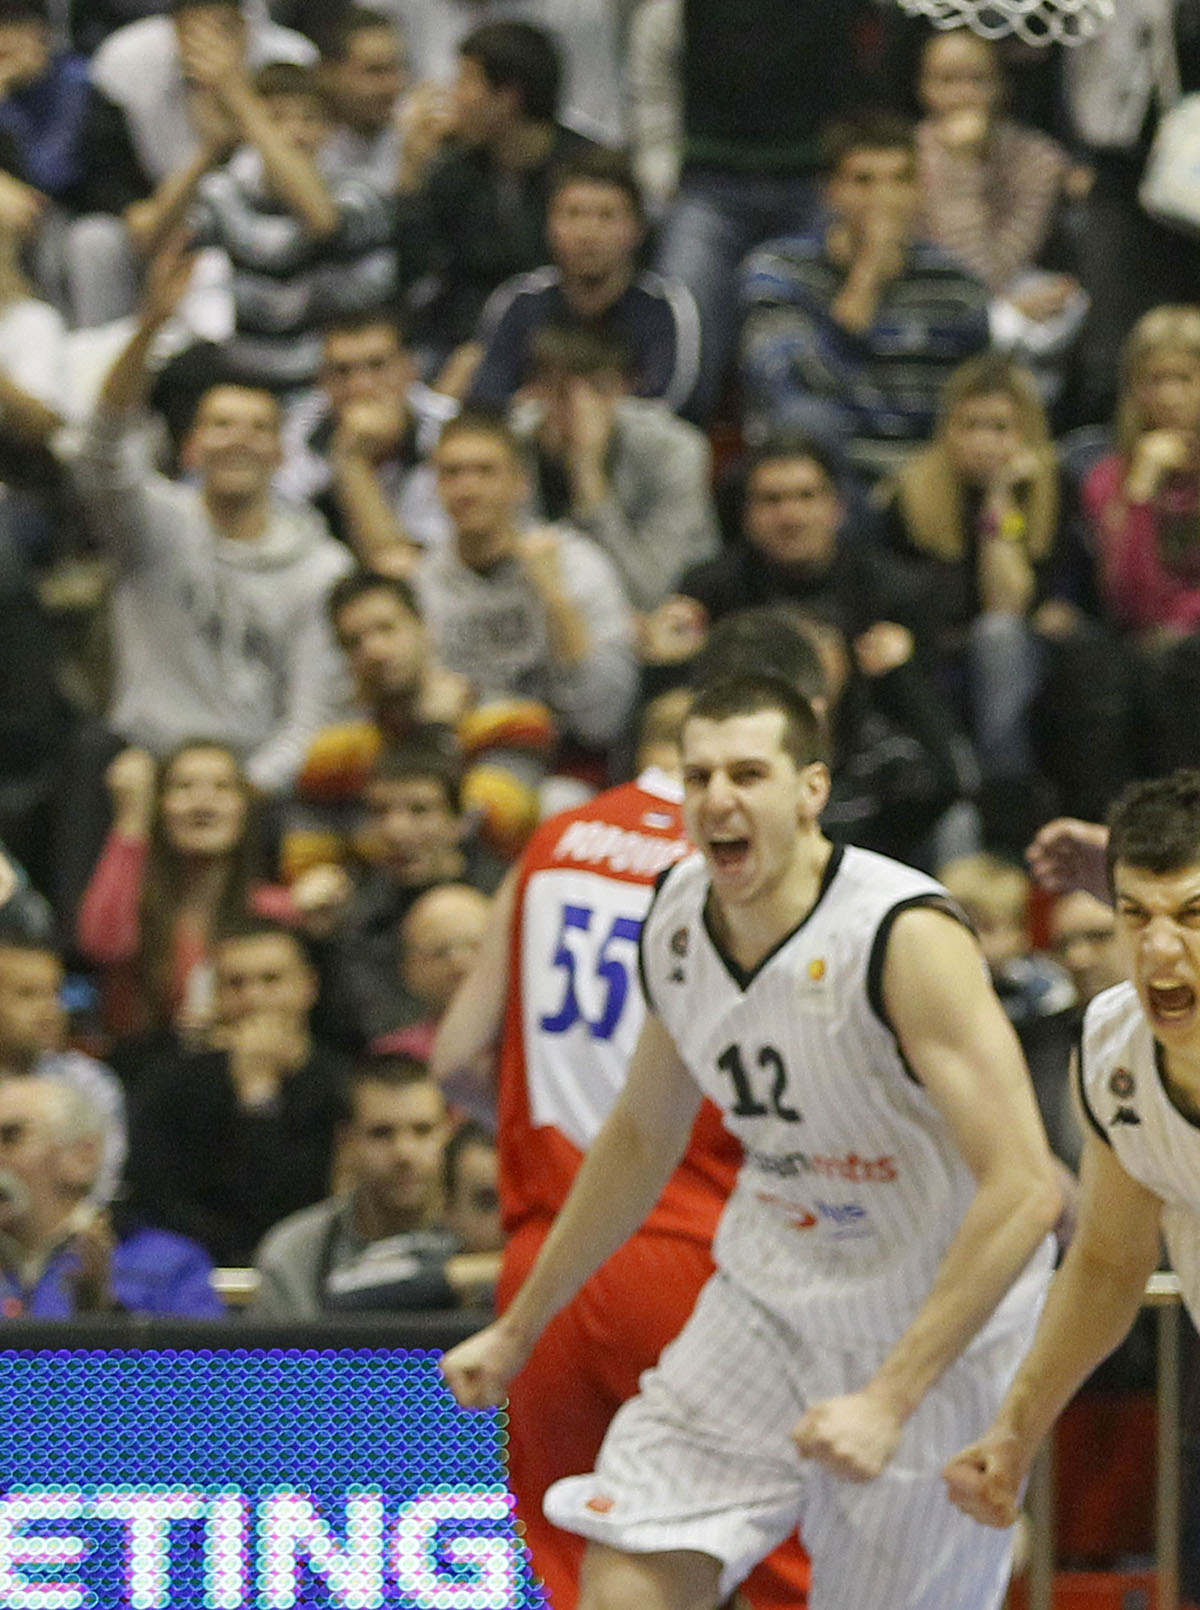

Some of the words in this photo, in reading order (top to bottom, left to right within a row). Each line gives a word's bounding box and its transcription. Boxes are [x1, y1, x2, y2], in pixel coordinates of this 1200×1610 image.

[539, 903, 645, 1041] 55
[717, 1044, 803, 1124] 12
[0, 1483, 522, 1610] ETING
